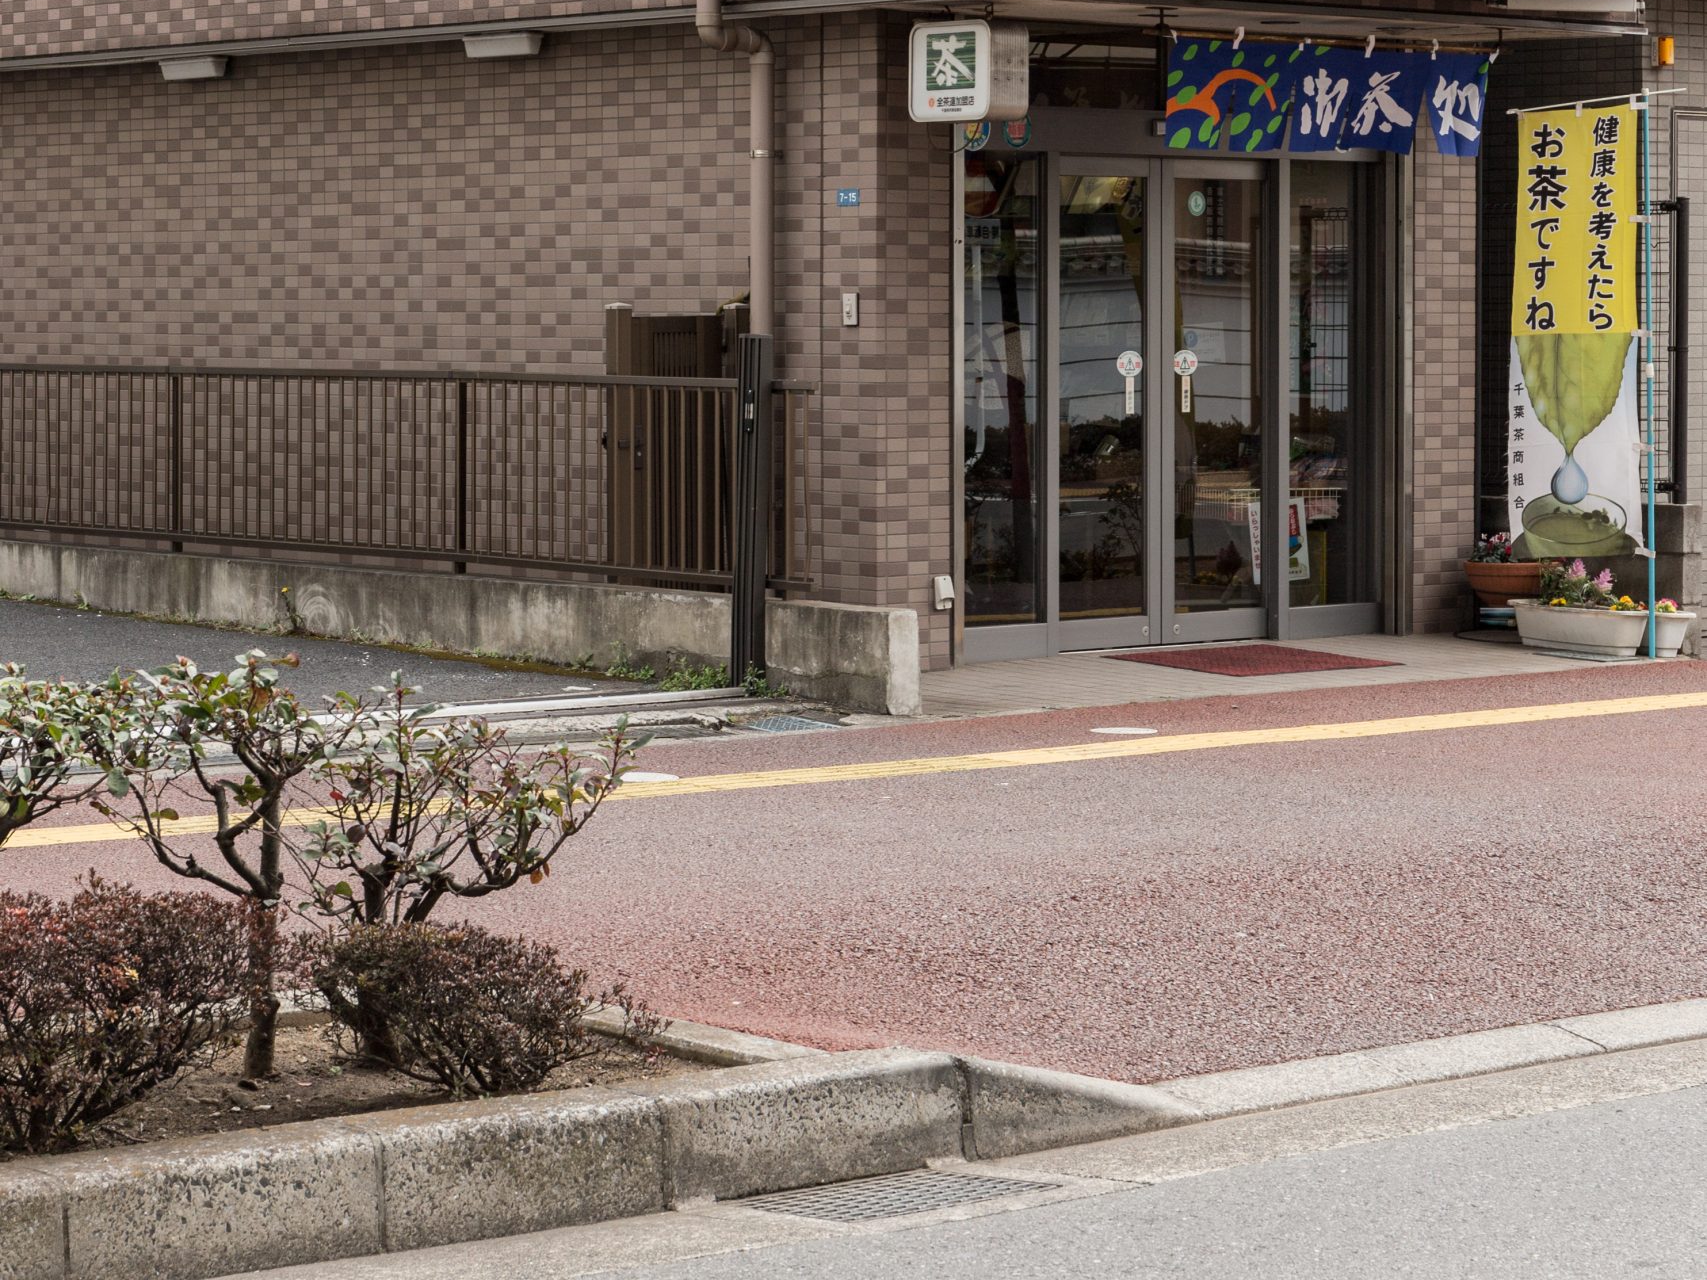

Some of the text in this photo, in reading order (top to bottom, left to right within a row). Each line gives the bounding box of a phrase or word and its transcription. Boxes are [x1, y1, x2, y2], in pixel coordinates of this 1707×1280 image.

[839, 192, 857, 203] 7-15
[1525, 123, 1568, 331] お茶ですね
[1587, 115, 1620, 331] 健康を考えたら
[1512, 382, 1526, 510] 千葉茶商組合
